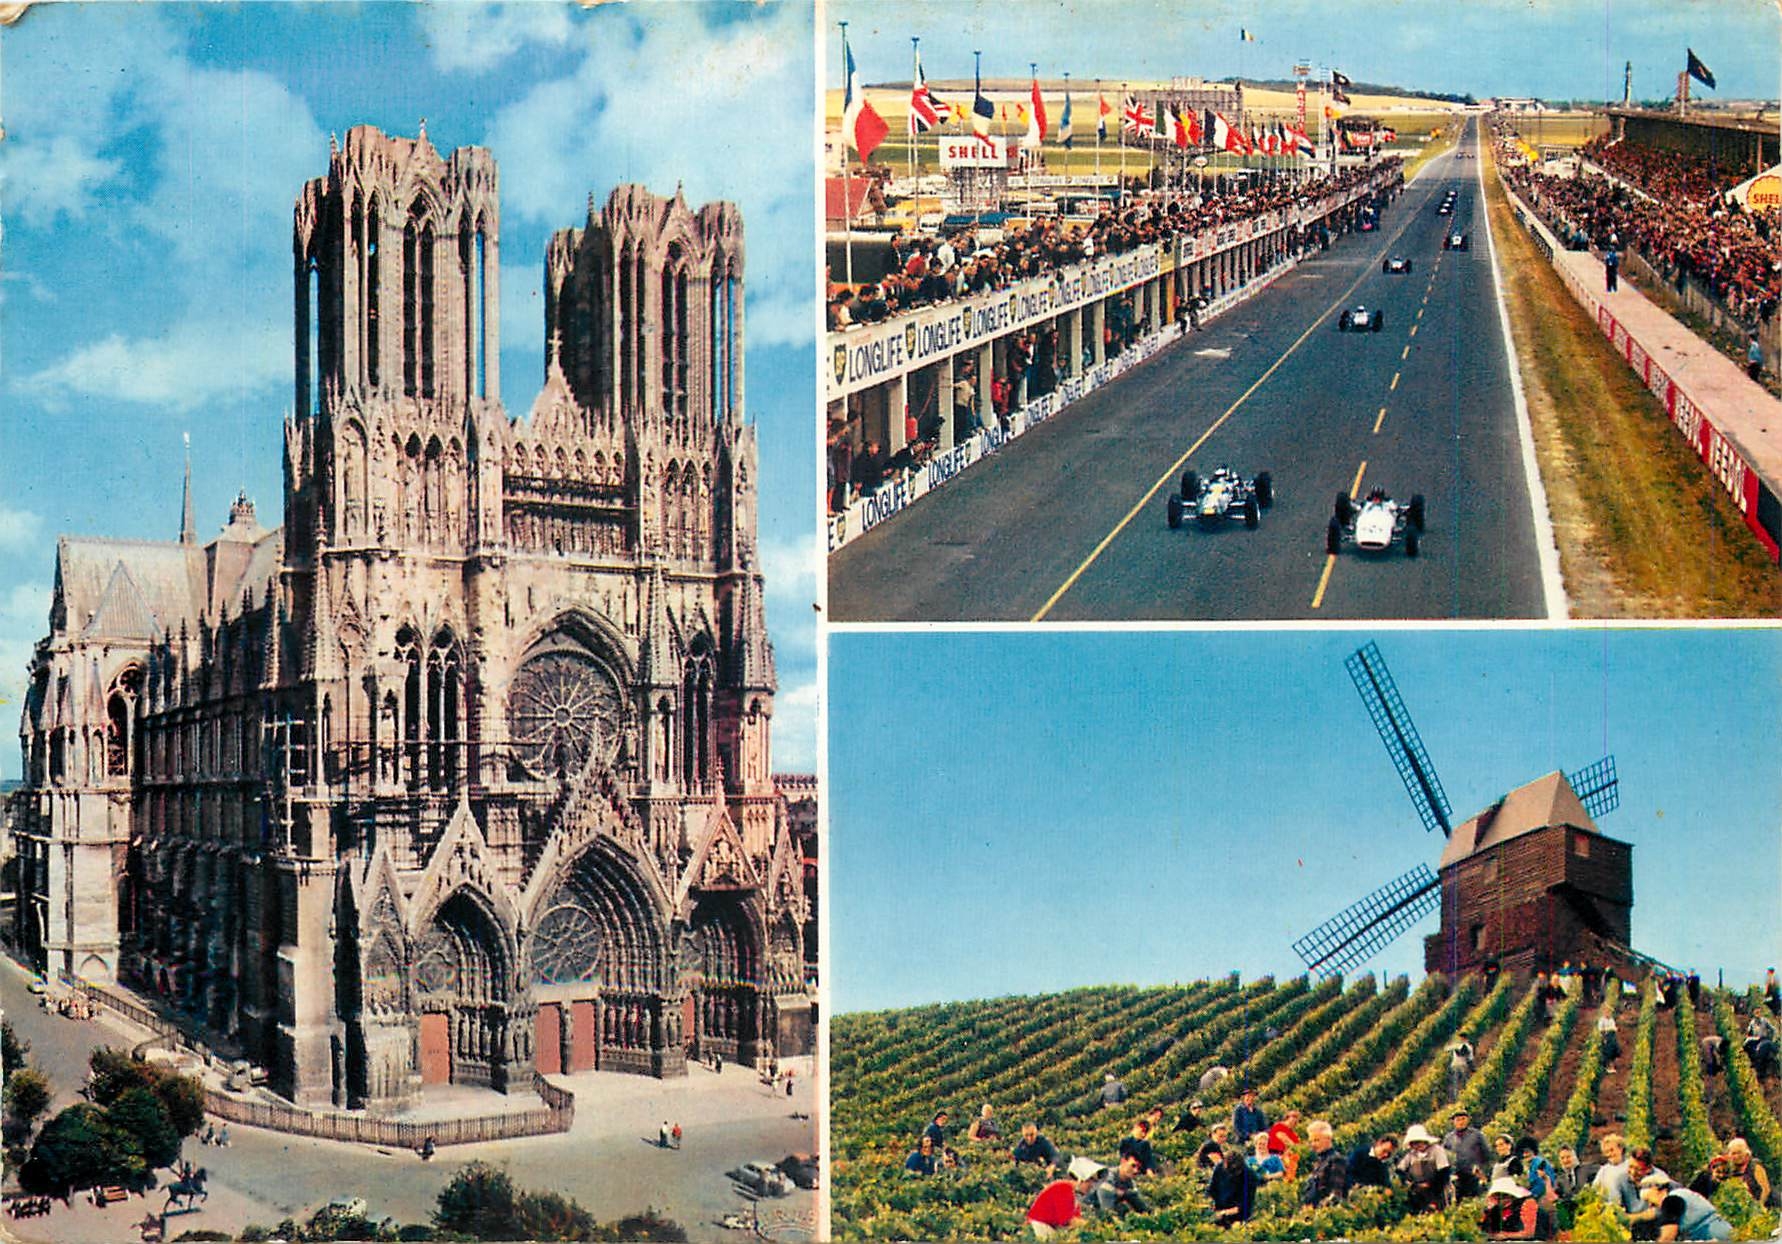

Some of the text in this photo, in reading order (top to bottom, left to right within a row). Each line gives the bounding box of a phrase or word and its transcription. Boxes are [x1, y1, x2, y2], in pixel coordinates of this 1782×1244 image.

[849, 334, 903, 383] LONGLIFE
[918, 316, 961, 358] LONGLIFE
[973, 301, 1008, 338] LONGLIFE
[862, 483, 907, 532] LONGLIFE
[929, 446, 965, 489] LONGLIFE
